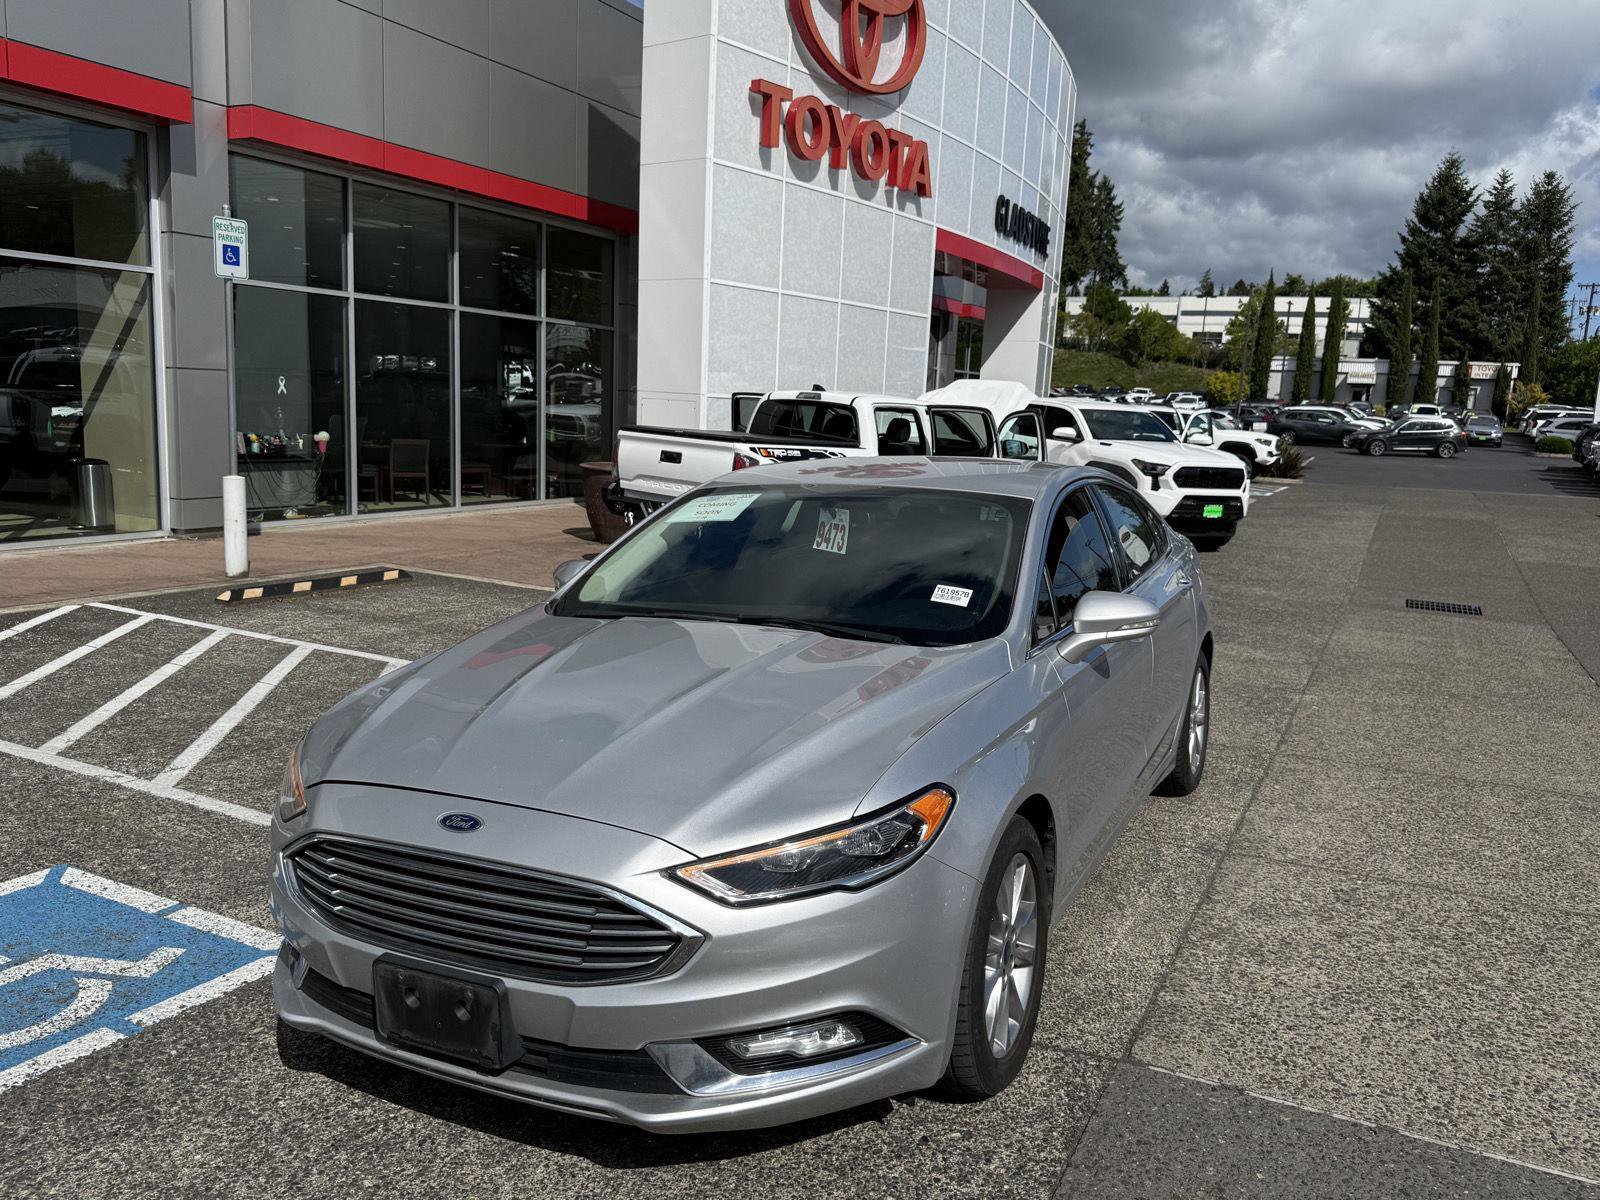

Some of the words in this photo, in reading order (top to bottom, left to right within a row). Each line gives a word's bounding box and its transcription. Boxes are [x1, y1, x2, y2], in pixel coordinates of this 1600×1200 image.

[751, 79, 932, 198] TOYOTA
[216, 222, 245, 235] RESERVED
[218, 233, 244, 244] PARKING
[1476, 365, 1498, 373] TOYO
[767, 449, 787, 458] TRD
[697, 501, 737, 509] COMING
[815, 521, 846, 552] 9473
[445, 815, 474, 829] Ford
